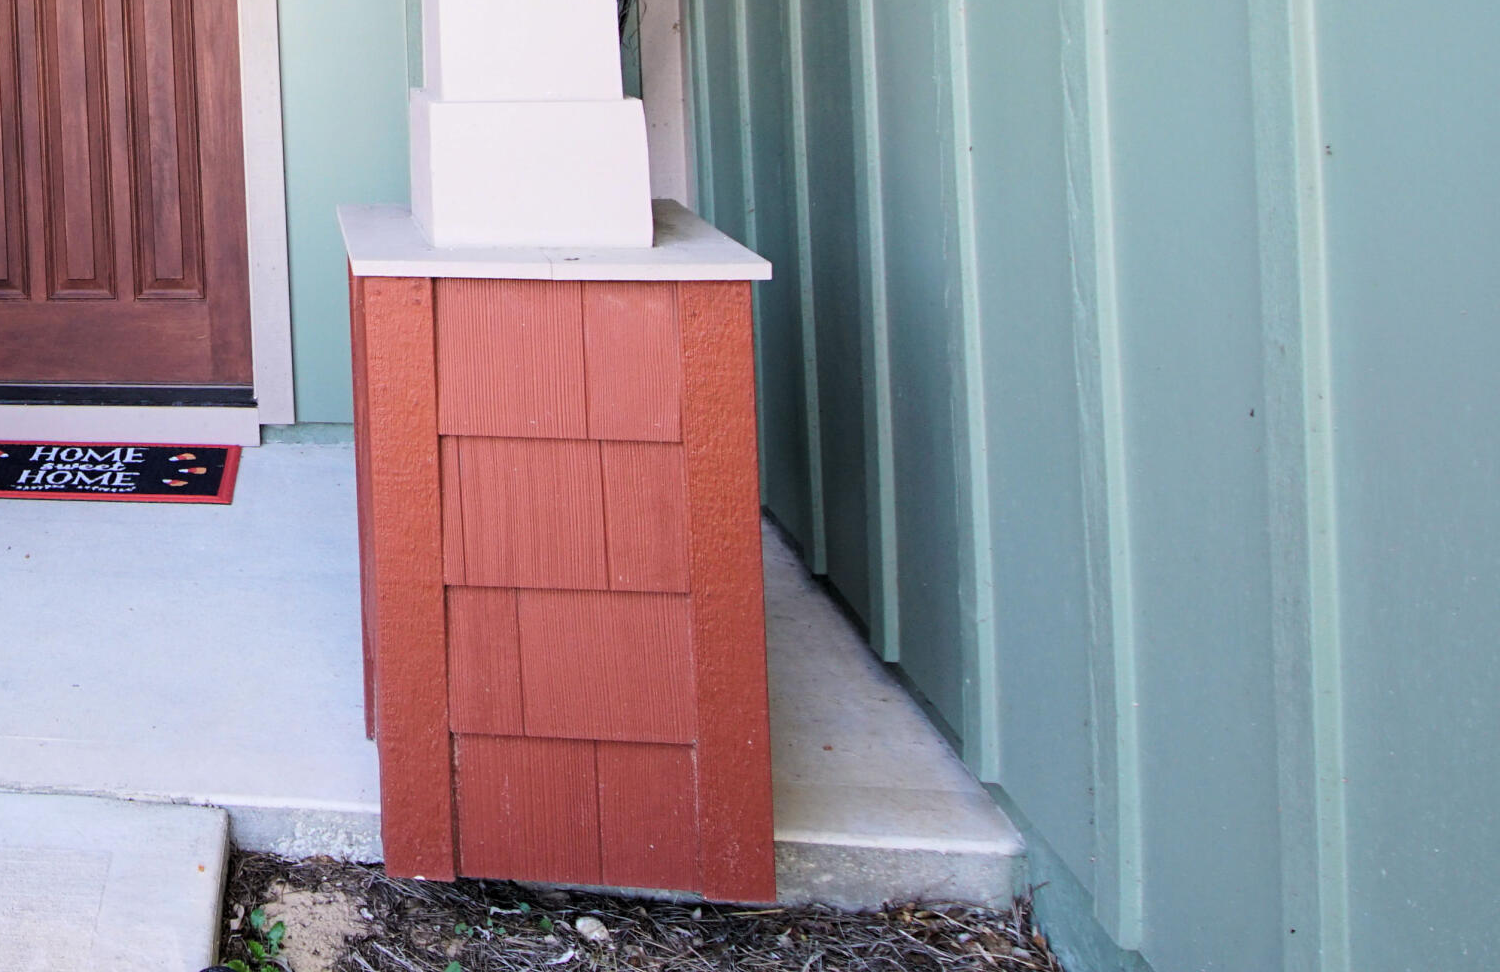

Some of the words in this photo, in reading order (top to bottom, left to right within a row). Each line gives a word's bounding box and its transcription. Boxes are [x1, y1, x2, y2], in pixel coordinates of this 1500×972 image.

[29, 446, 149, 463] HOME
[40, 461, 126, 471] sweet
[17, 469, 140, 486] HOME
